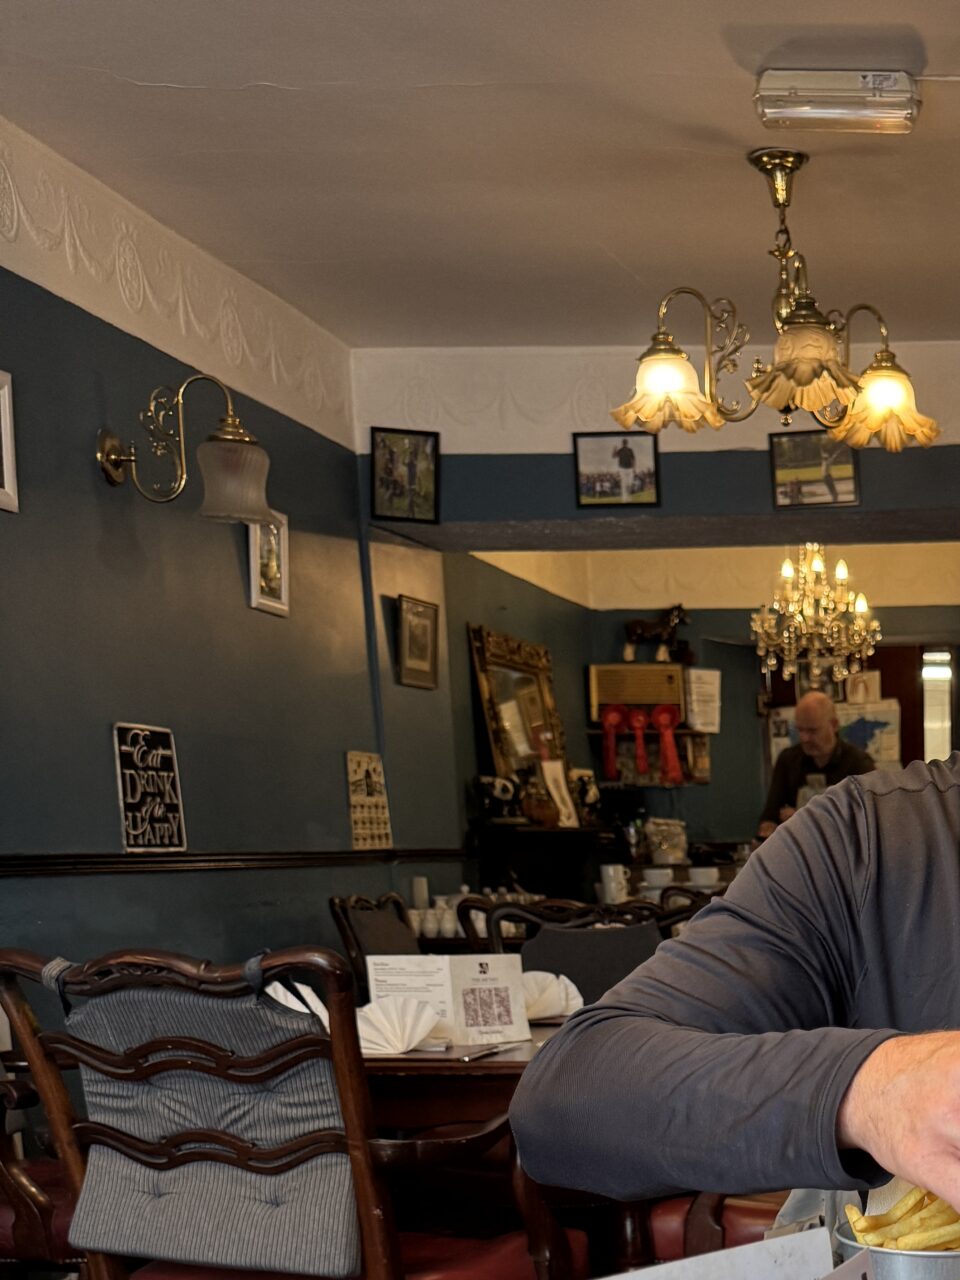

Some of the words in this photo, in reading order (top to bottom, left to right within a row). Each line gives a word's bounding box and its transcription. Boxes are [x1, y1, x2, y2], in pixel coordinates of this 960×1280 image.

[128, 730, 162, 768] Eat
[123, 769, 178, 804] DRINK
[126, 812, 180, 845] HAPPY
